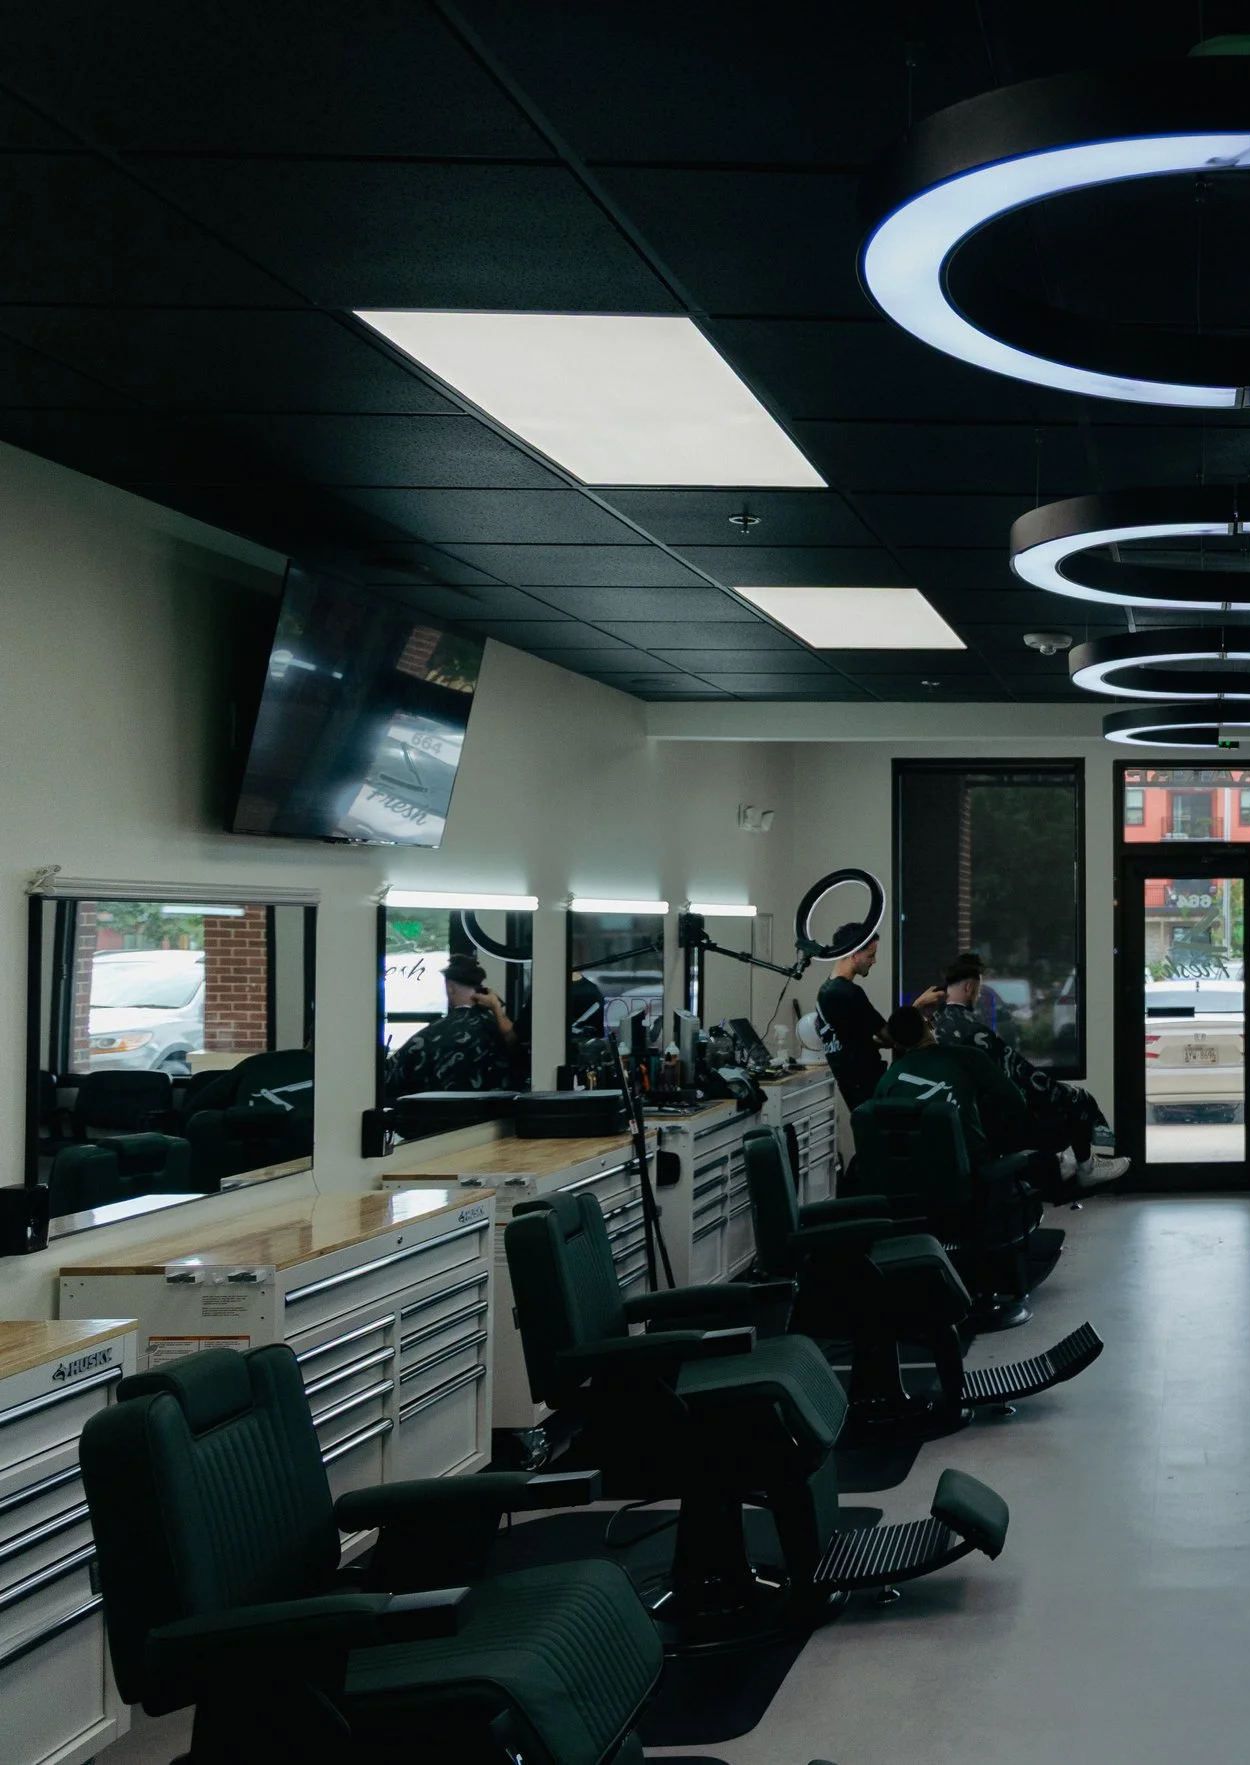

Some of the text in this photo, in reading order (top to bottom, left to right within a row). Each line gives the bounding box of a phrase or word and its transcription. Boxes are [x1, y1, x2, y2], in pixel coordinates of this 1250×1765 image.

[411, 732, 442, 754] 664
[366, 788, 427, 826] Fresh
[67, 1347, 112, 1377] HUSKY
